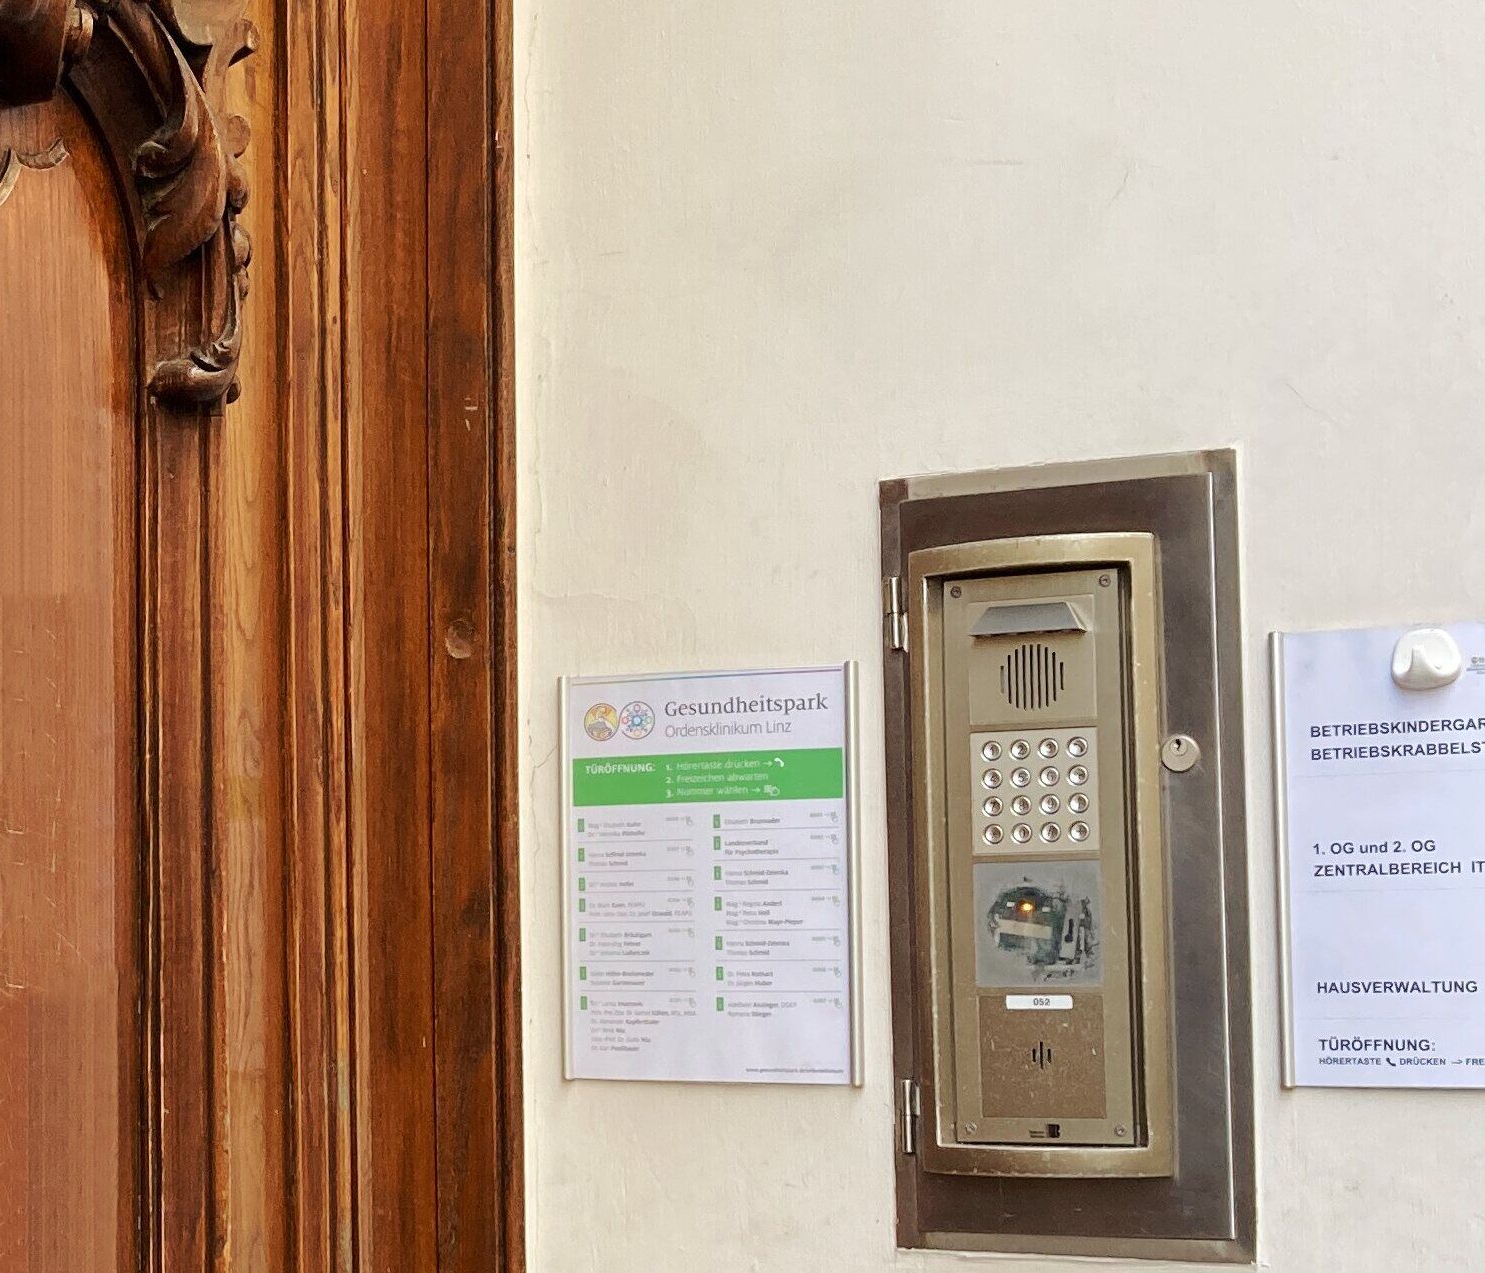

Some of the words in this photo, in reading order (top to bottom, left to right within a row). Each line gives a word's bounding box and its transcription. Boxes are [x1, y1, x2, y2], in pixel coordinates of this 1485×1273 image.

[665, 692, 828, 717] Gesundheitspark
[665, 723, 763, 738] Ordensklinikum
[766, 720, 792, 734] Linz
[1311, 741, 1485, 761] BETRIEBSKRABBELS
[665, 776, 674, 784] 2.
[1313, 843, 1326, 855] 1.
[1330, 842, 1354, 854] OG
[1359, 841, 1388, 853] und
[1393, 840, 1406, 853] 2.
[1411, 839, 1436, 852] OG
[1313, 860, 1461, 877] ZENTRALBEREICH
[1471, 861, 1485, 873] IT
[1317, 980, 1478, 994] HAUSVERWALTUNG
[1033, 998, 1051, 1006] 052
[1318, 1035, 1436, 1052] TÜRÖFFNUNG:
[1318, 1056, 1382, 1066] HÖRERTASTE
[1399, 1056, 1446, 1066] DRÜCKEN
[1465, 1057, 1485, 1066] FRE
